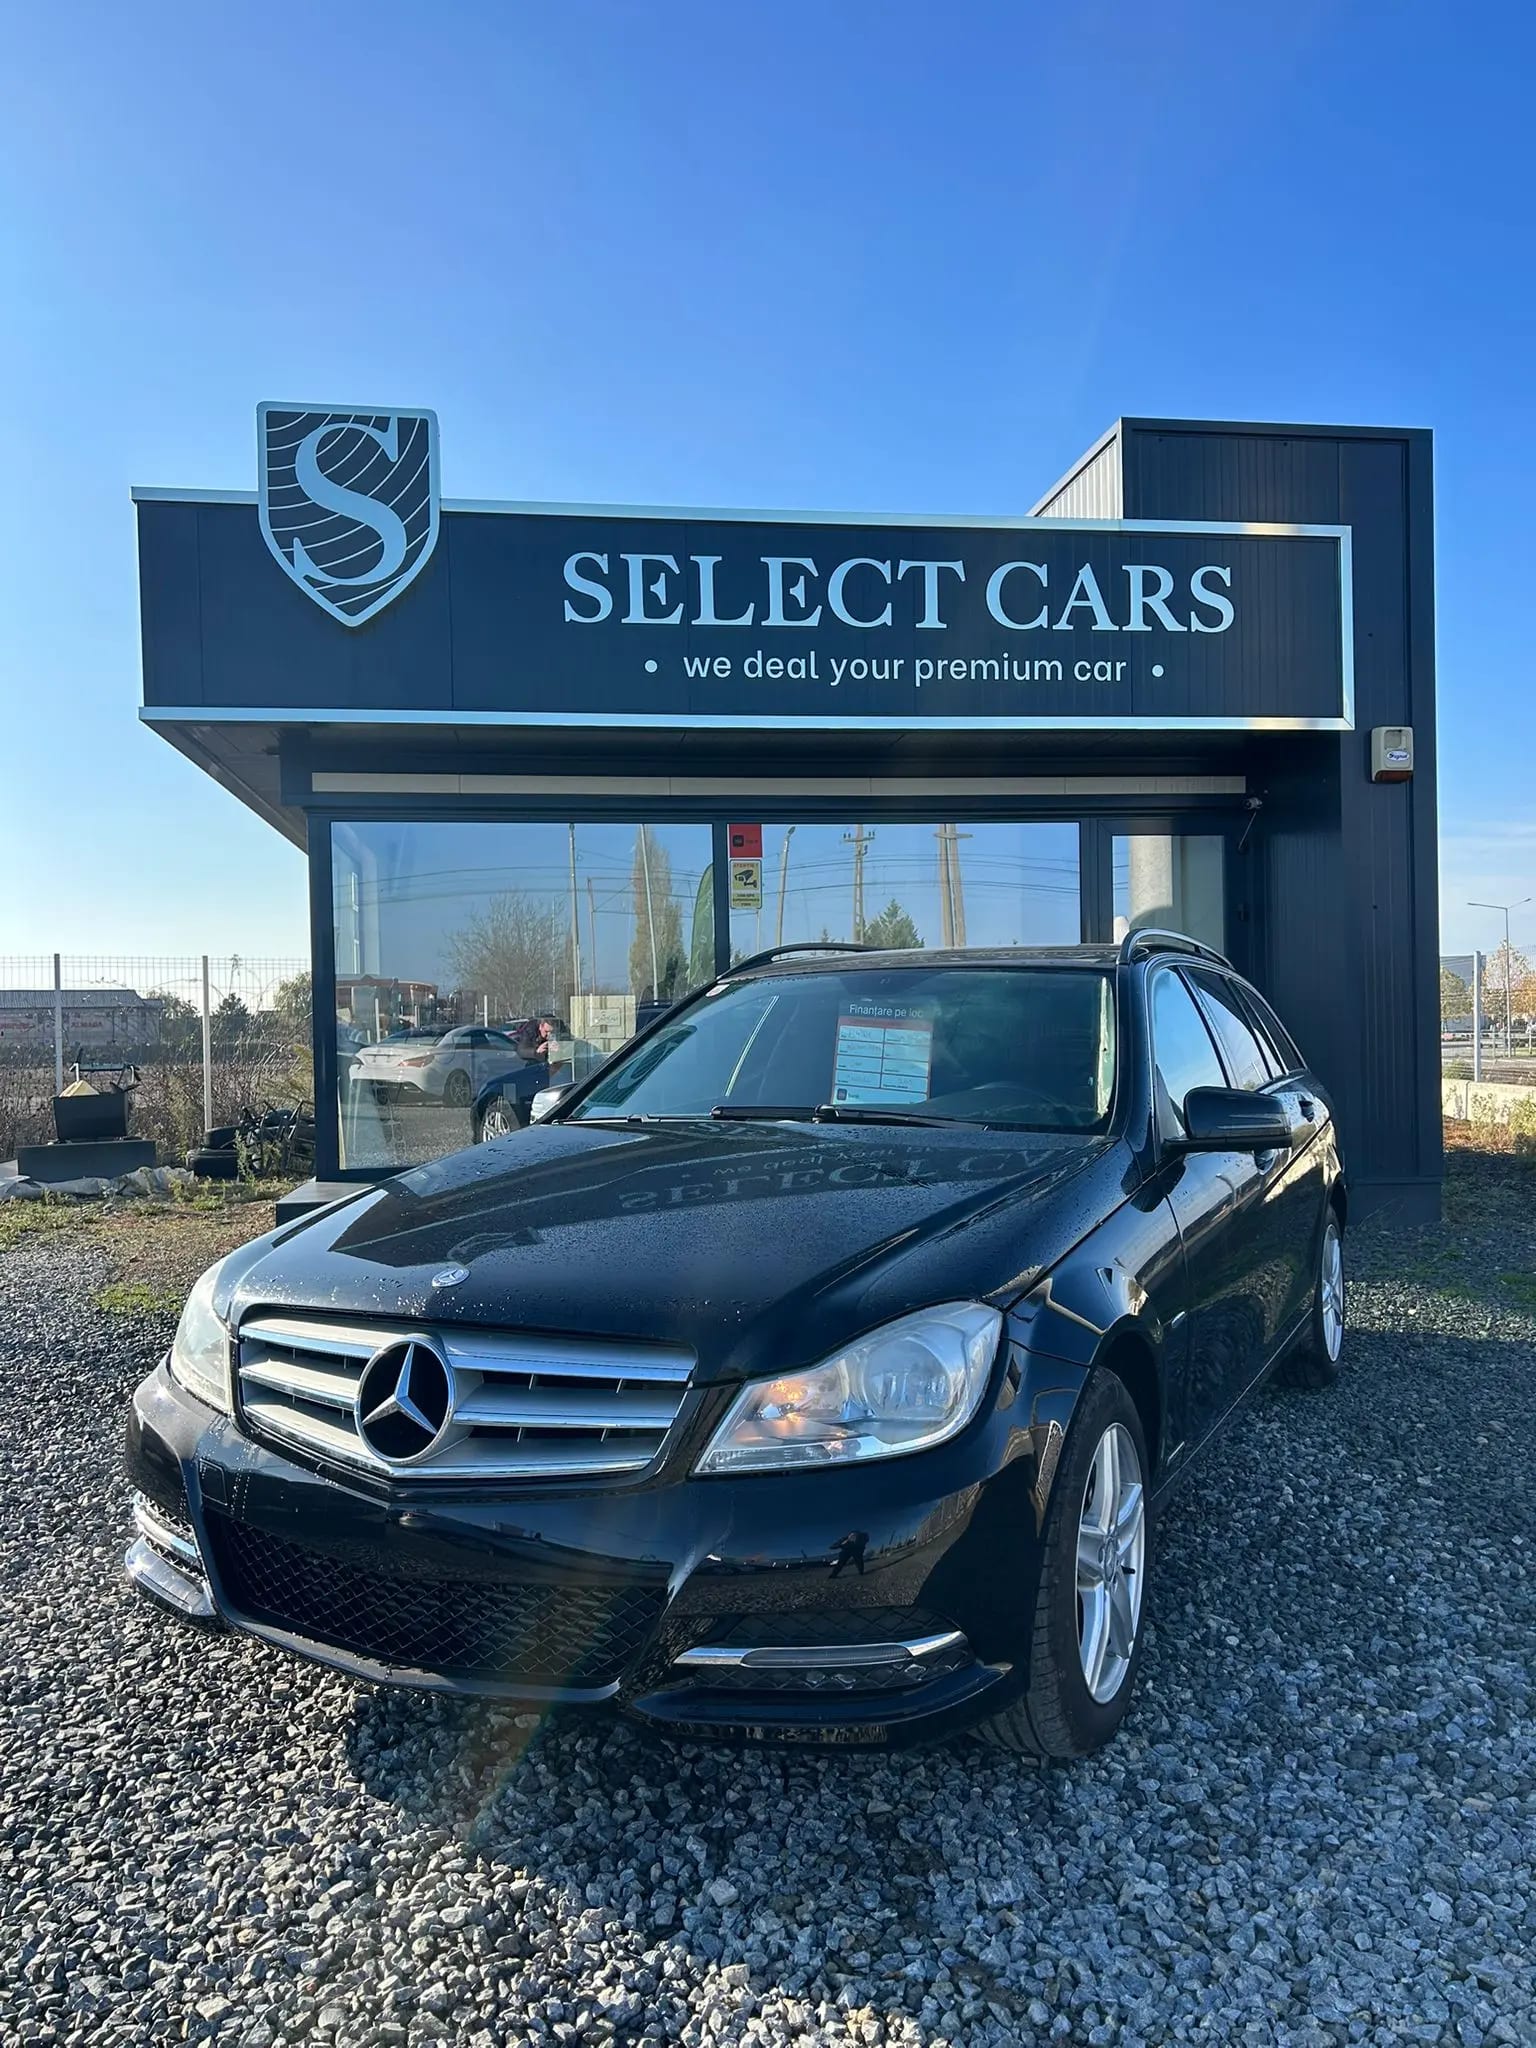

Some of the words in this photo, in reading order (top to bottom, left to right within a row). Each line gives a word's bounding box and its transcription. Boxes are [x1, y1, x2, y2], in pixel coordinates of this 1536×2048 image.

[562, 551, 966, 631] SELECT
[985, 562, 1236, 634] CARS
[683, 656, 732, 679] we
[743, 650, 820, 679] deal
[830, 658, 905, 688] your
[915, 652, 1063, 688] premium
[1073, 660, 1127, 682] car
[894, 1008, 907, 1018] pe
